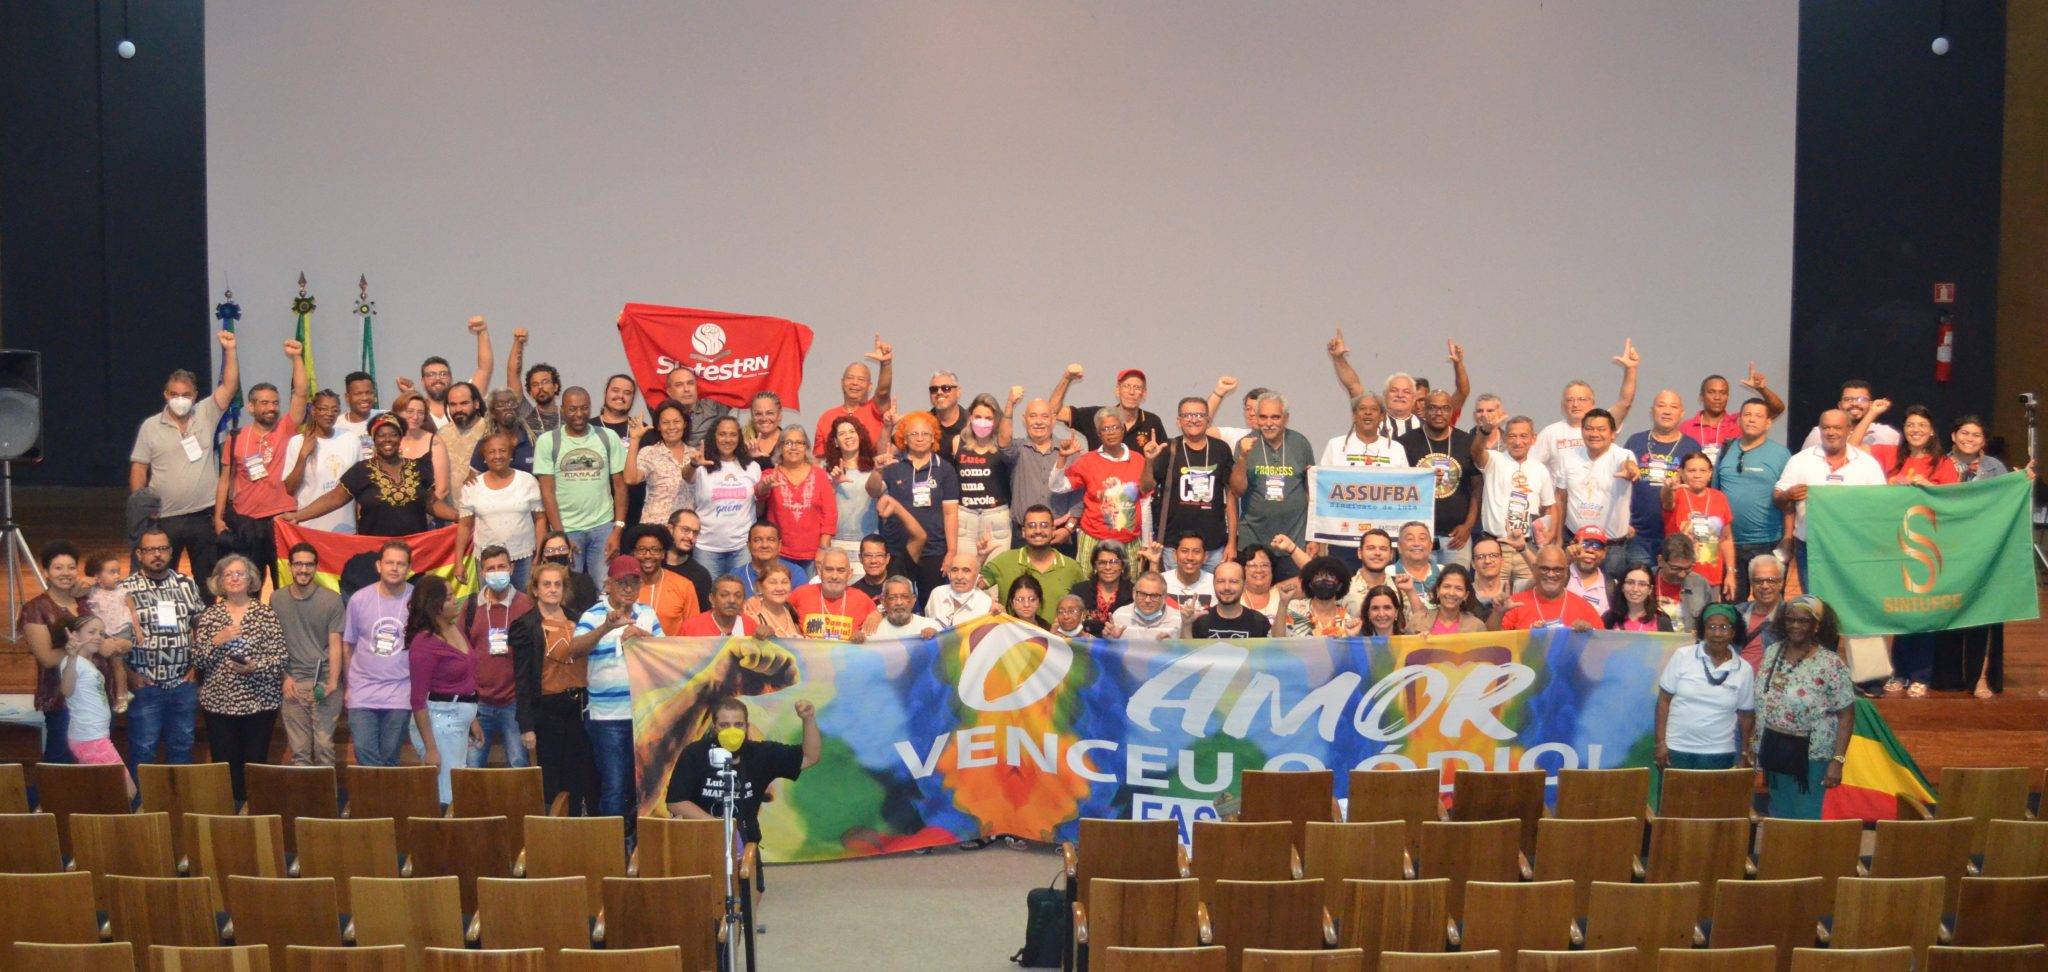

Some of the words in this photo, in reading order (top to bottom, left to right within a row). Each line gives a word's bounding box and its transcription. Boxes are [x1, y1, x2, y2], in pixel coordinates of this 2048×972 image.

[960, 468, 991, 477] como
[961, 482, 985, 491] uma
[1329, 484, 1420, 503] ASSUFBA
[958, 622, 1073, 712] O
[1126, 641, 1536, 743] AMOR
[894, 725, 1234, 794] VENCEU
